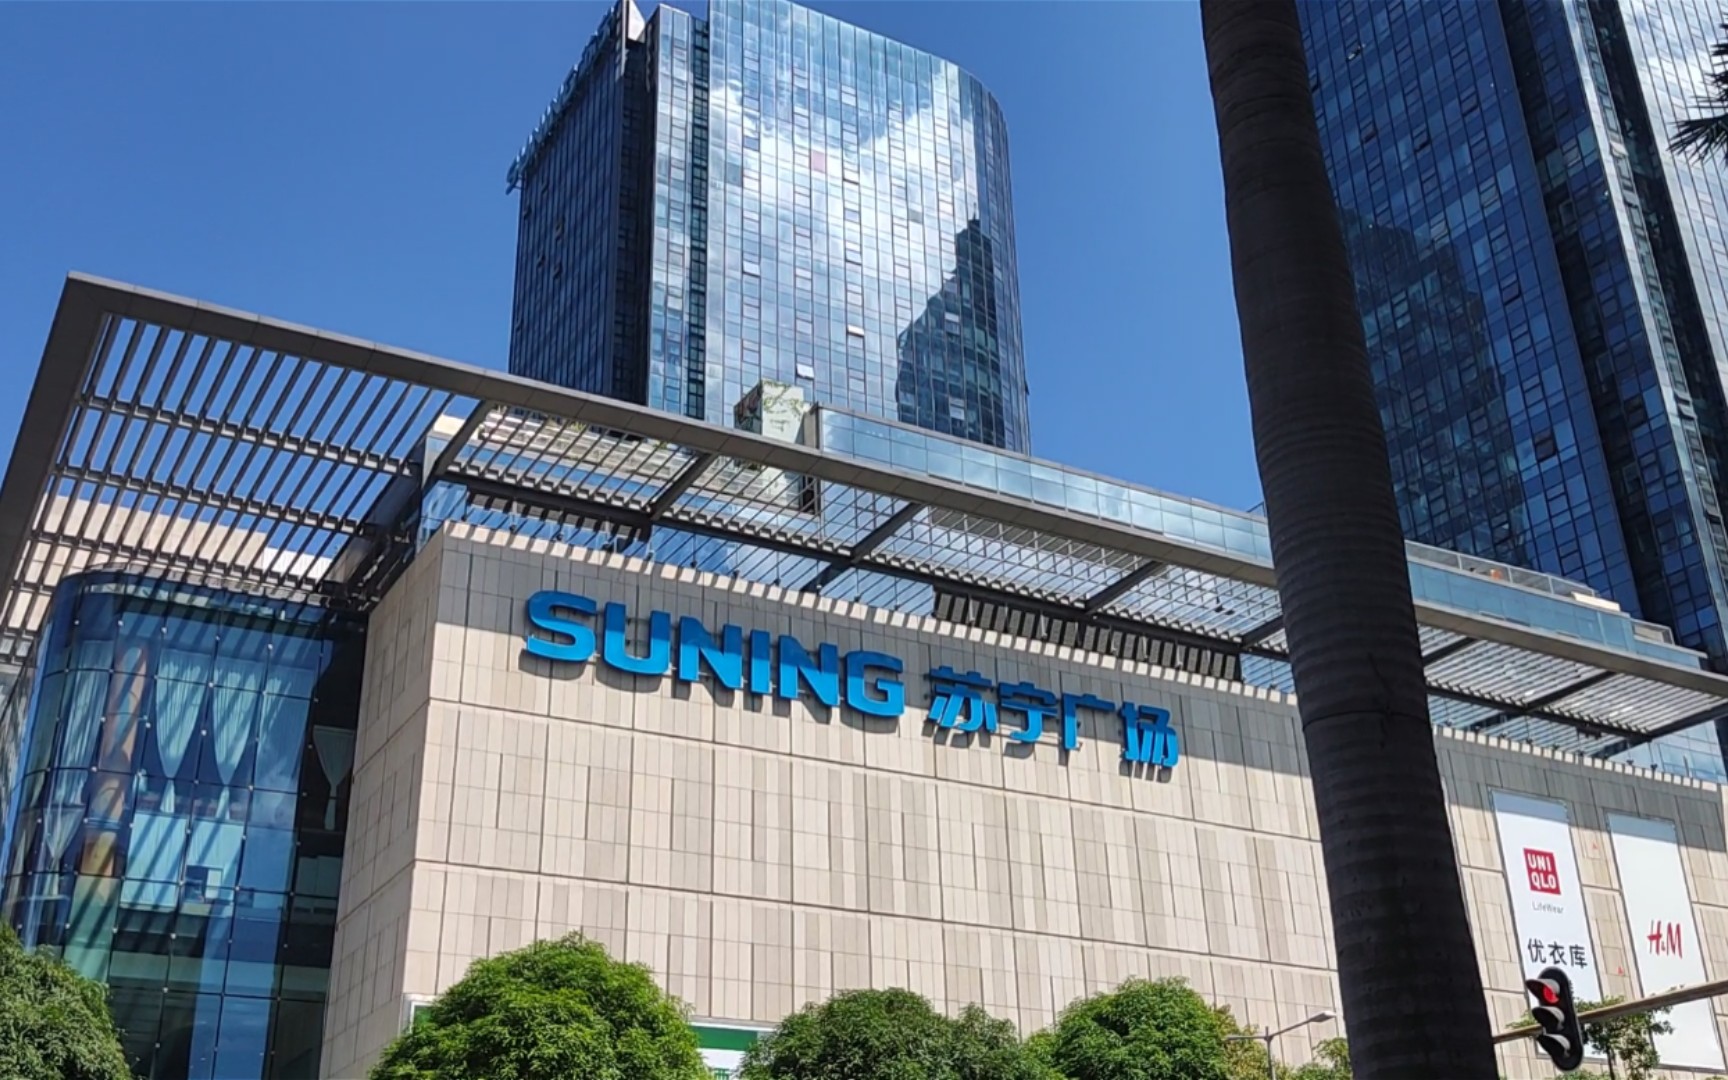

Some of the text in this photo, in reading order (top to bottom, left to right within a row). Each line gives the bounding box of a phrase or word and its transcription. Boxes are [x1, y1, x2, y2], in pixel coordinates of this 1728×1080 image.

[526, 590, 1180, 767] SUNING 苏宁广场
[1527, 853, 1552, 872] UNI
[1530, 871, 1557, 890] QLO
[1531, 901, 1564, 915] LifeWear
[1646, 919, 1683, 959] H&M
[1527, 938, 1588, 969] 优衣库
